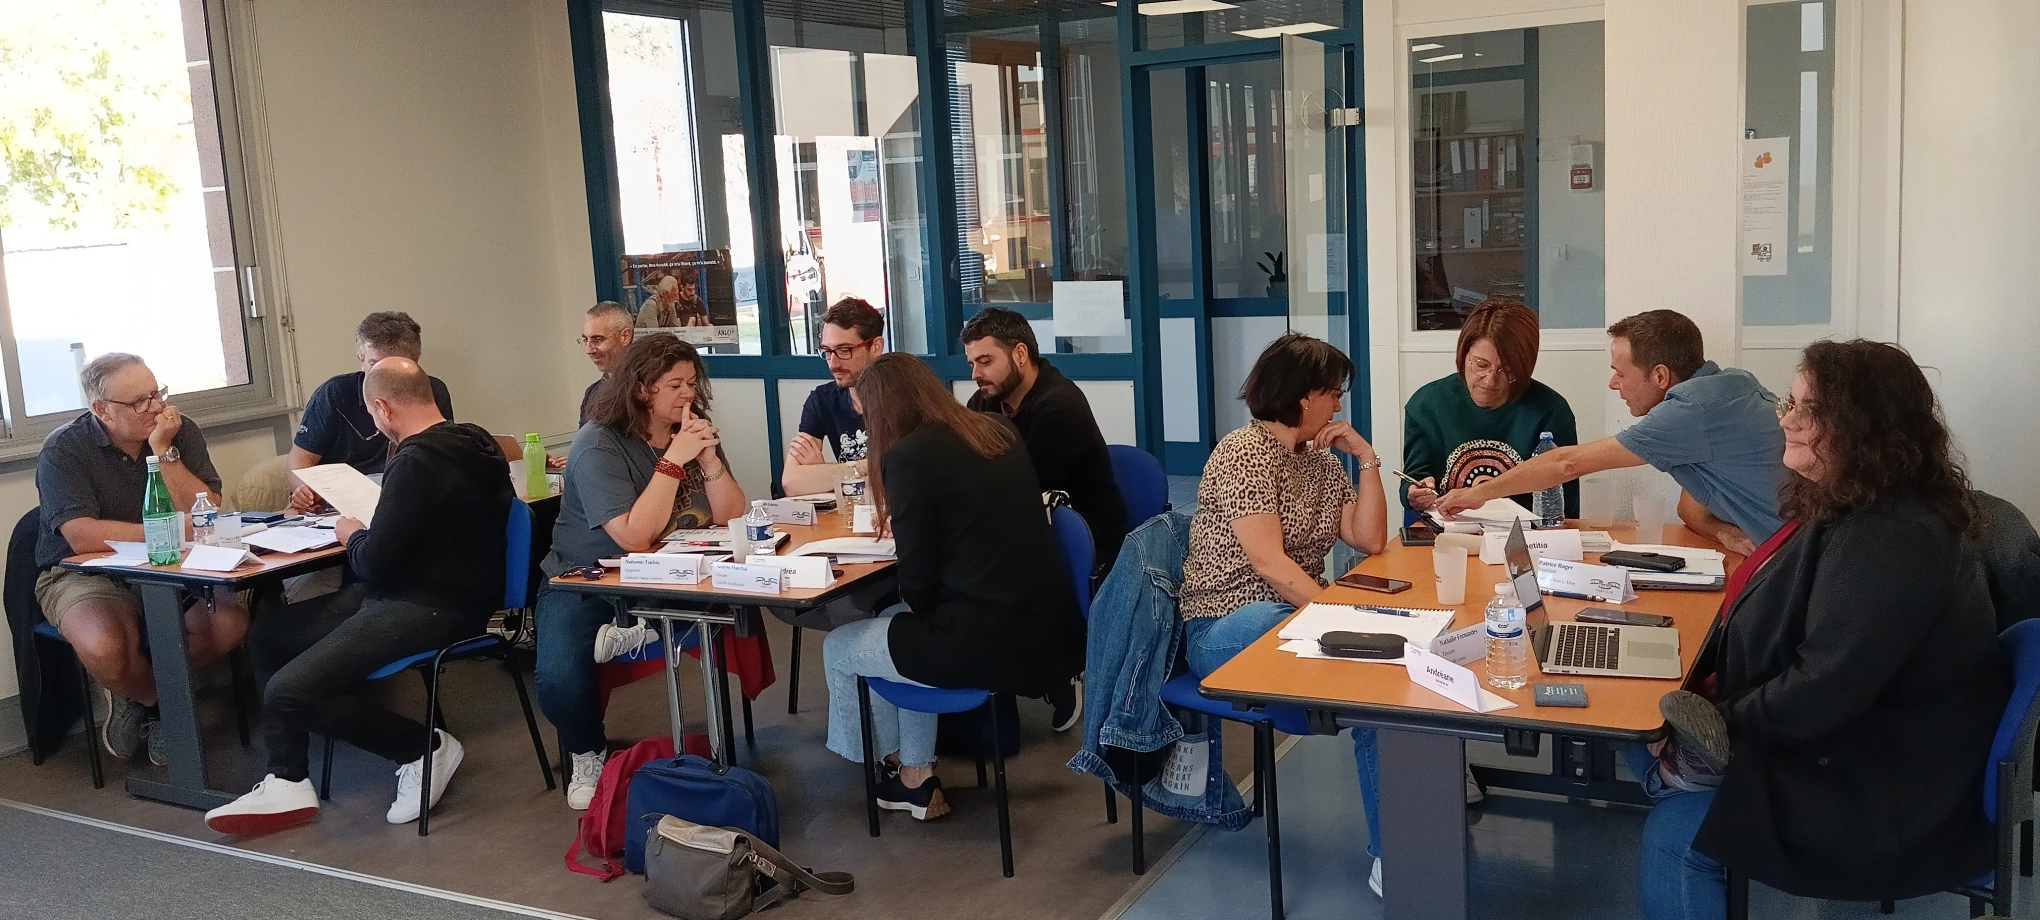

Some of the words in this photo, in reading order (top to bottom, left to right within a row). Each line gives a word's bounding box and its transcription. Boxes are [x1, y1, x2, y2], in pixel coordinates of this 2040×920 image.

[1539, 560, 1557, 568] Patrice
[1164, 768, 1192, 781] GREAT
[1163, 777, 1190, 791] AGAIN
